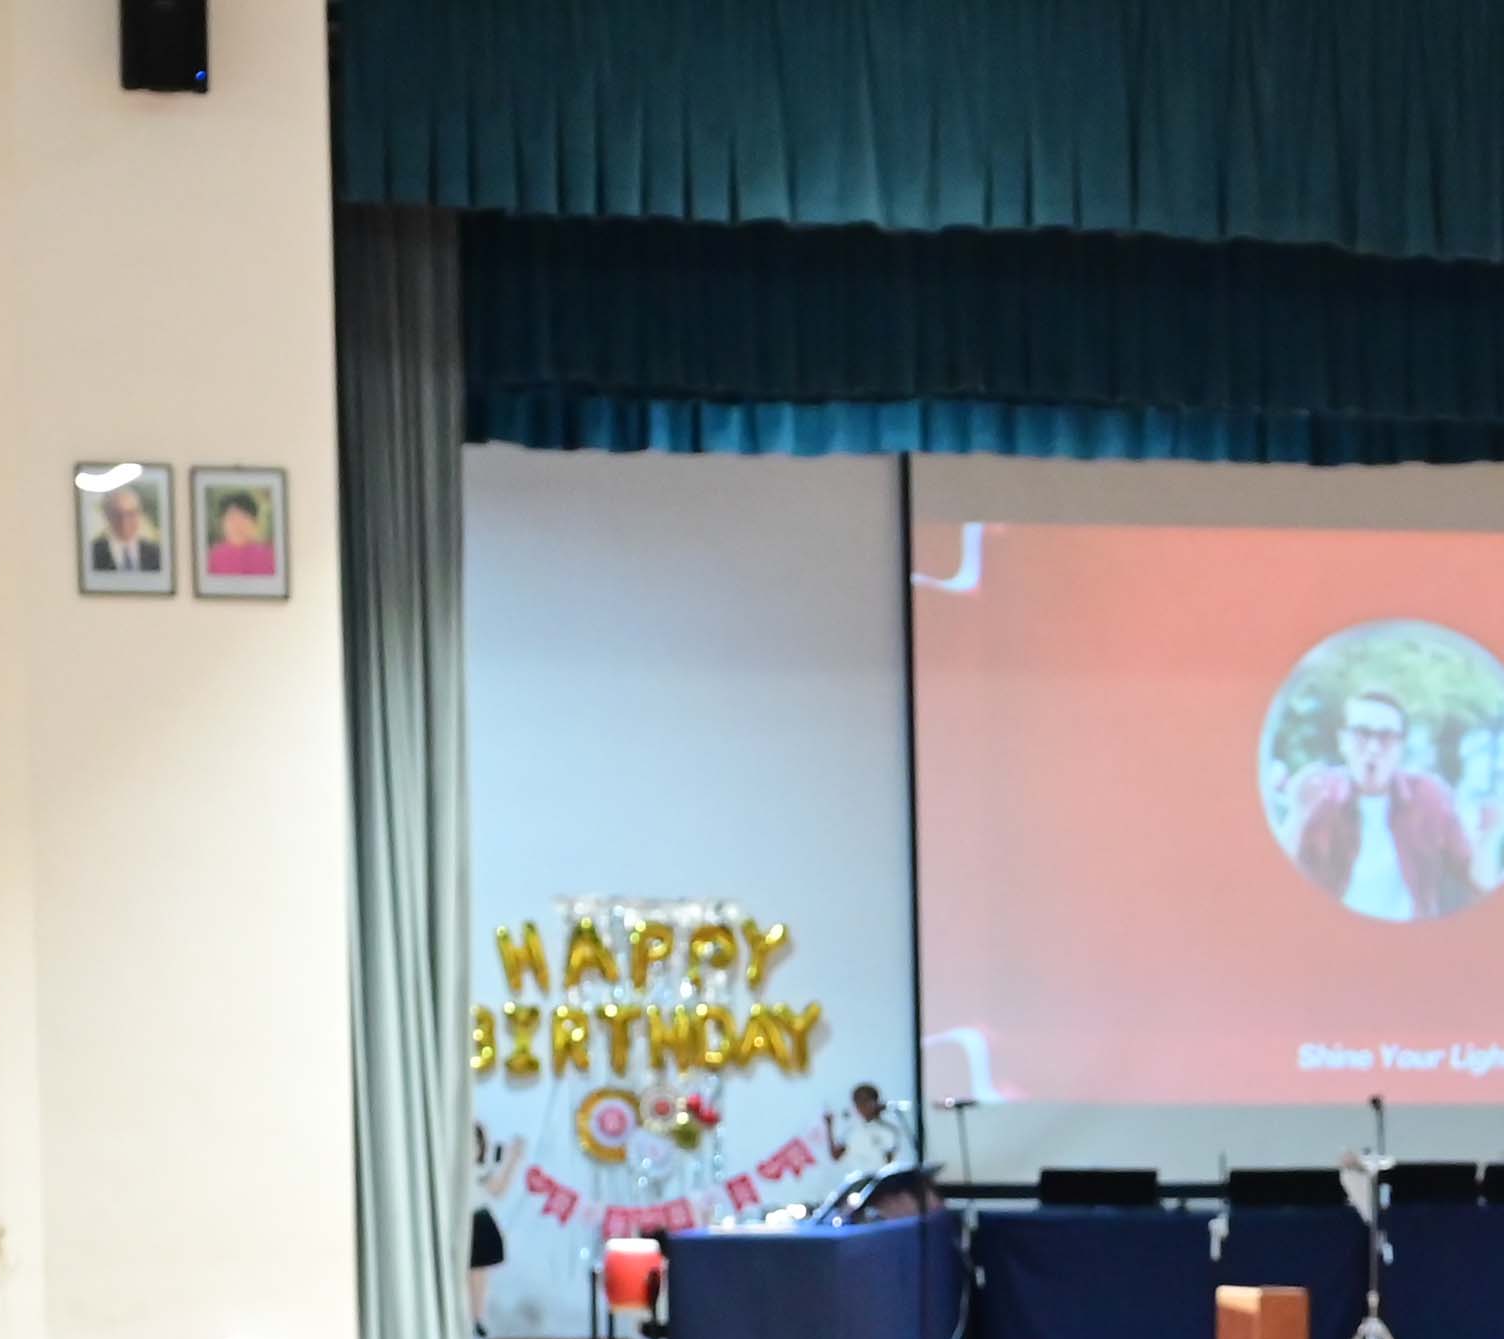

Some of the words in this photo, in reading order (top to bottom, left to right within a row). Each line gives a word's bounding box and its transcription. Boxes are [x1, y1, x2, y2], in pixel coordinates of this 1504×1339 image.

[496, 917, 790, 992] HAPPY
[1298, 1042, 1373, 1071] Shine
[1379, 1042, 1446, 1070] Your
